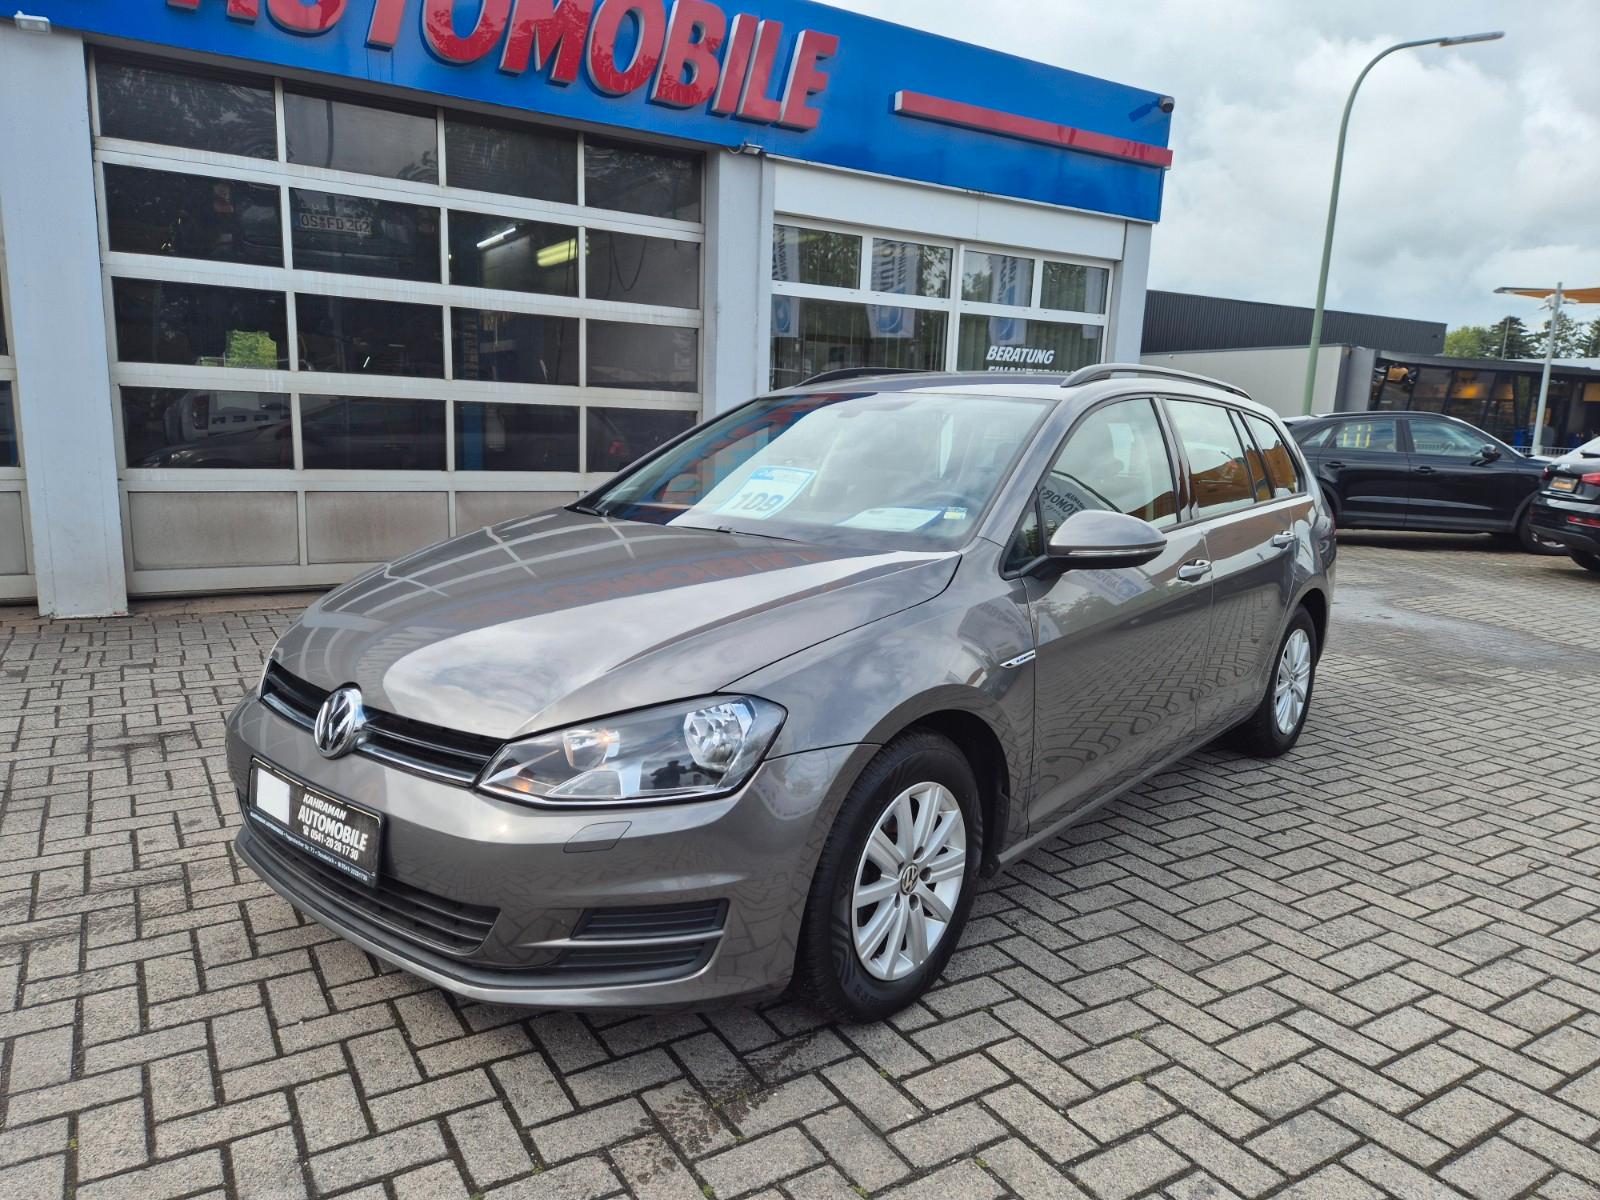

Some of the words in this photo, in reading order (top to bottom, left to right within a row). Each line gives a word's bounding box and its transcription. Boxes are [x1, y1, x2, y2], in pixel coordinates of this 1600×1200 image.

[166, 0, 840, 130] OMOBILE
[986, 345, 1055, 364] BERATUNG
[731, 492, 785, 511] 109
[303, 794, 347, 820] KAHRAMAN
[298, 805, 368, 852] AUTOMOBILE
